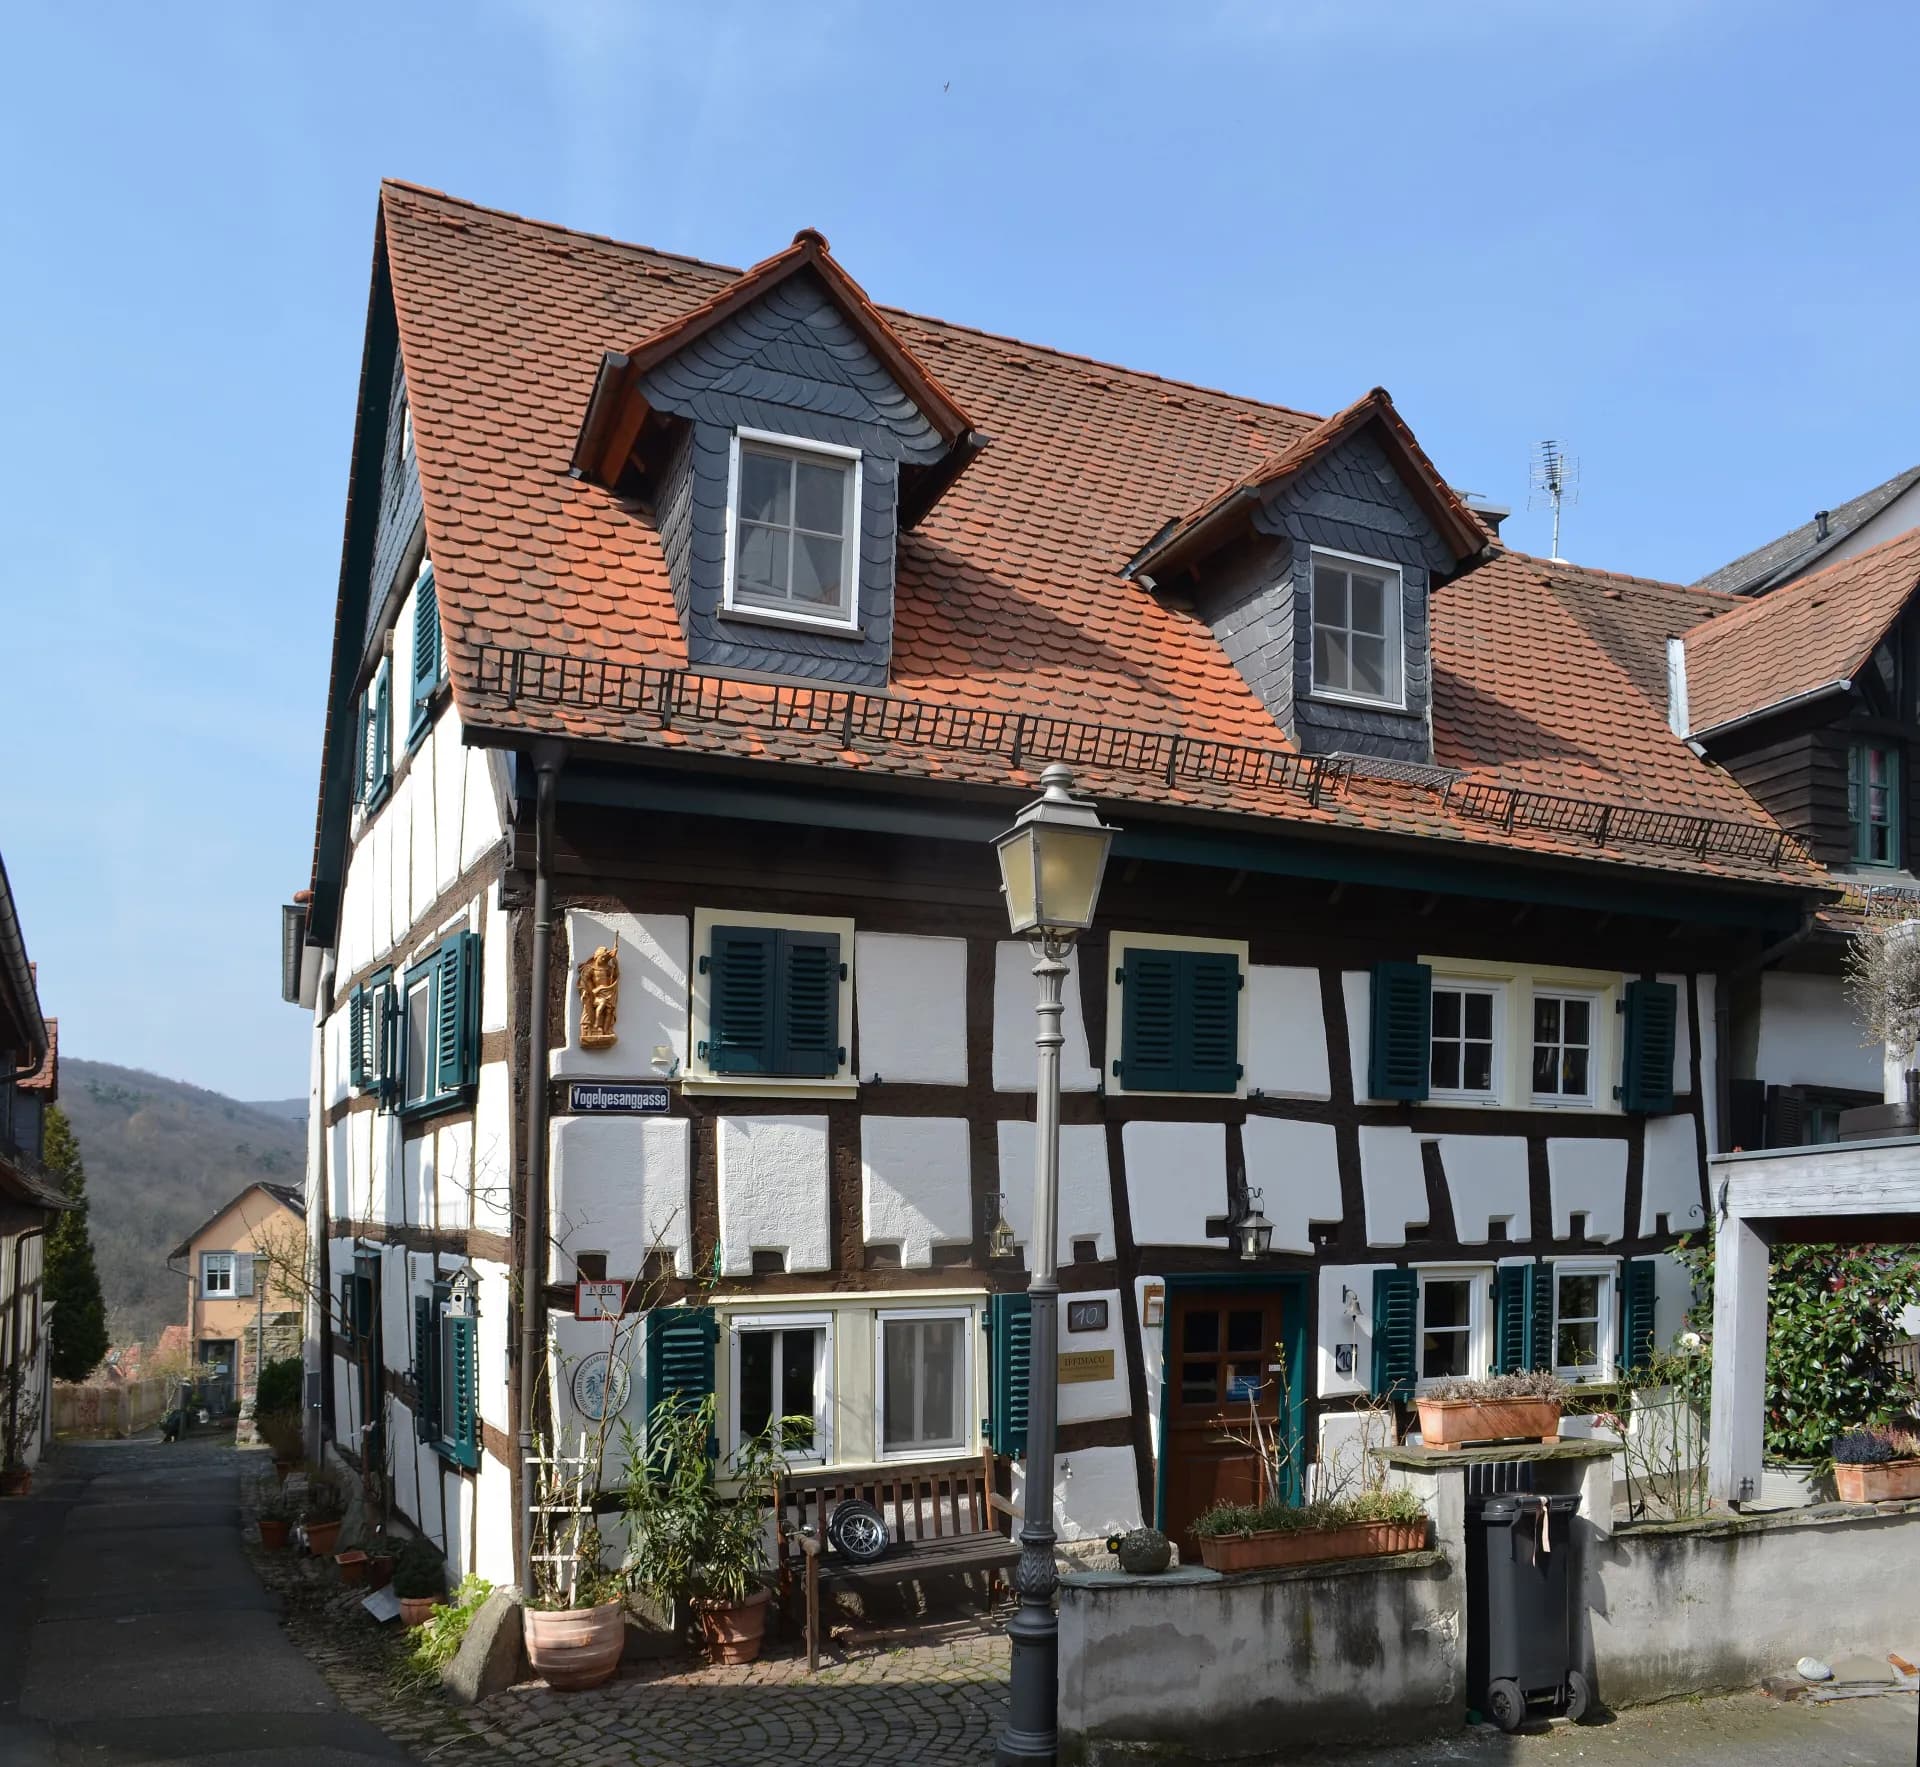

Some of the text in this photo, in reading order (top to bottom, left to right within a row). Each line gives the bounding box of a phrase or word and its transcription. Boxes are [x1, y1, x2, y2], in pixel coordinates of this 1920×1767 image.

[574, 1087, 667, 1109] Vogelgesanggasse
[601, 1285, 613, 1294] 80
[1075, 1307, 1098, 1325] 10
[1339, 1351, 1353, 1369] 10
